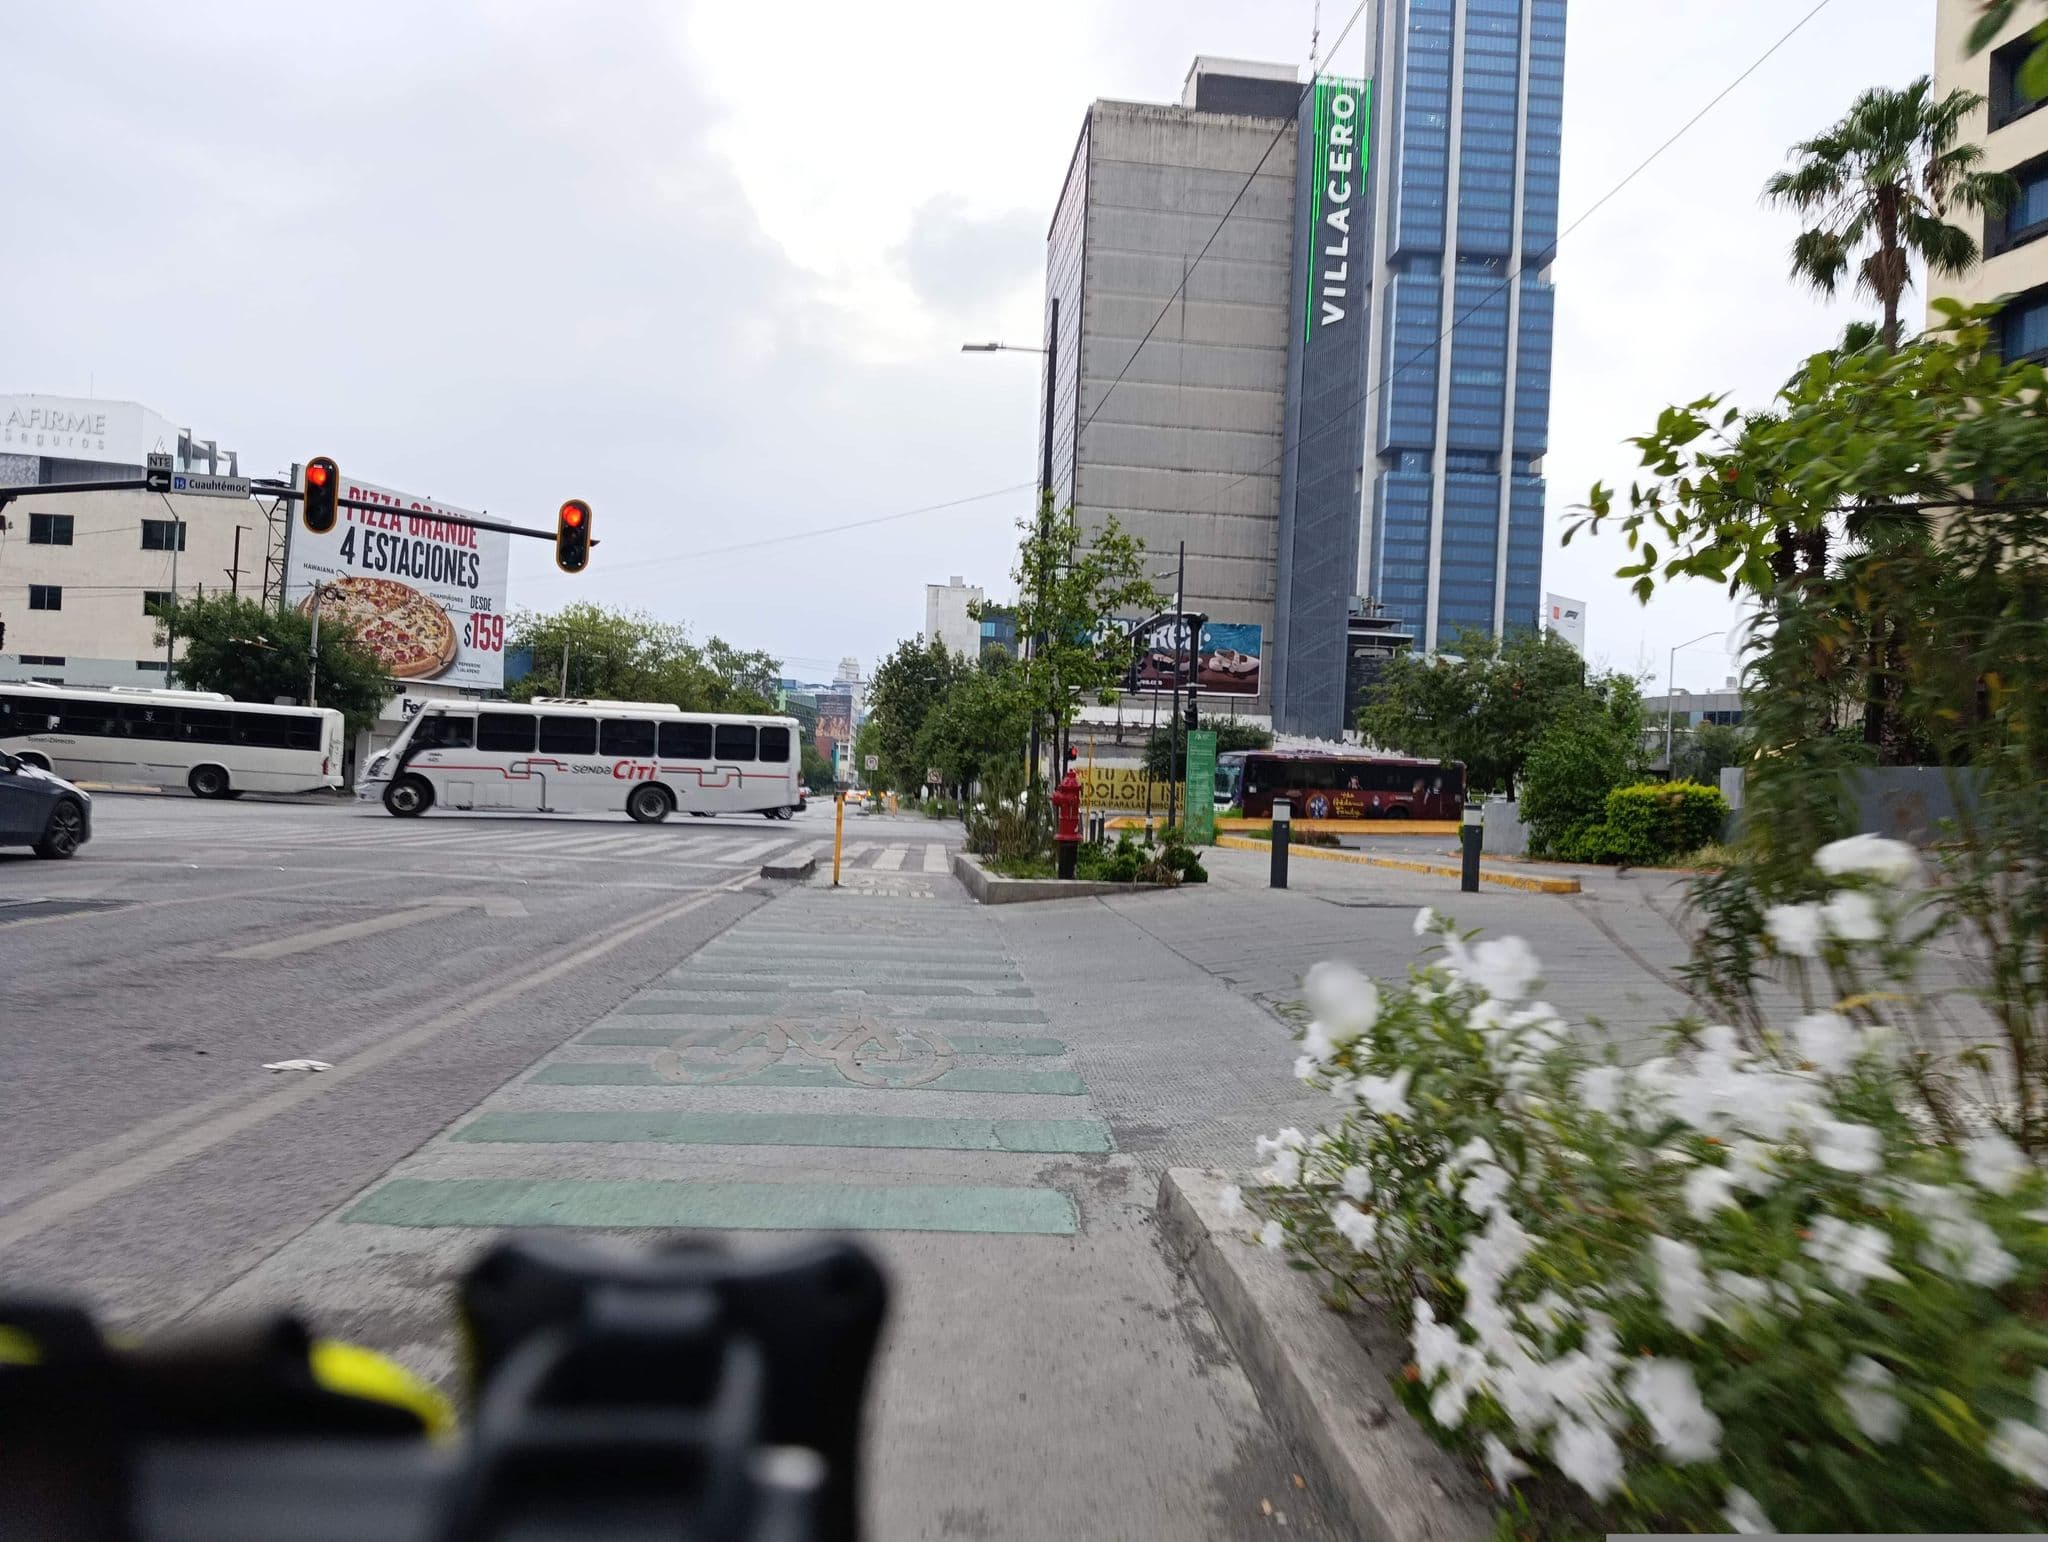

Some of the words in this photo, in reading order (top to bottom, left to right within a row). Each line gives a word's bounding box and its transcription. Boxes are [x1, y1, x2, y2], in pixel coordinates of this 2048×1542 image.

[1320, 93, 1356, 326] VILLACERO
[5, 406, 106, 435] AFIRME
[189, 479, 247, 493] Cuauhtémoc
[346, 486, 402, 532] PIZZA
[408, 502, 477, 549] GRANDE
[340, 526, 356, 565] 4
[362, 529, 480, 589] ESTACIONES
[470, 594, 492, 612] DESDE
[463, 611, 504, 652] $159
